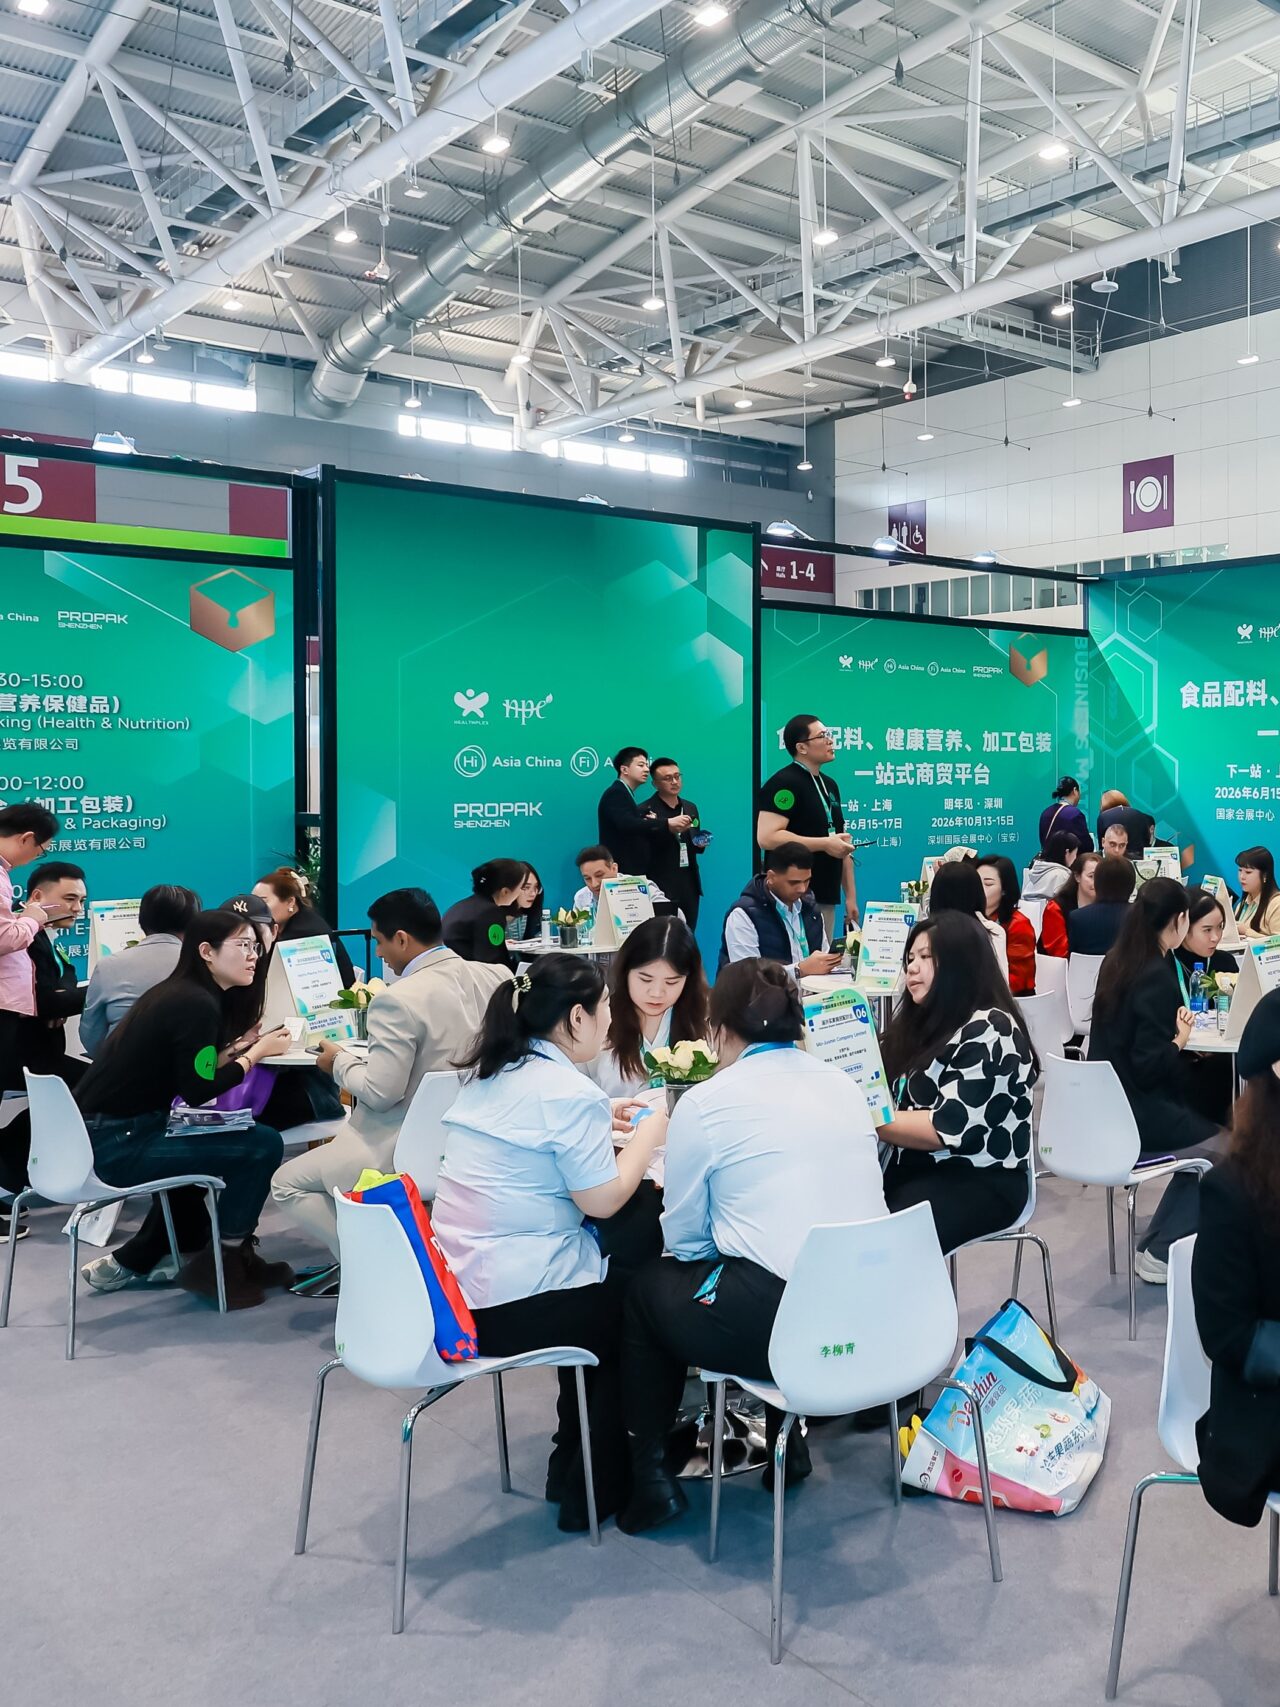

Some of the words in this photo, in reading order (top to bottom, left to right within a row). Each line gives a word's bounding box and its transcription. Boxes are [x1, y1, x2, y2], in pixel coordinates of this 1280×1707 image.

[3, 454, 43, 514] 5
[790, 560, 816, 581] 1-4
[7, 612, 40, 622] China
[57, 611, 129, 624] PROPAK
[57, 621, 103, 630] SHENZHEN
[972, 666, 1003, 674] PROPAK
[37, 714, 95, 729] (Health
[101, 717, 113, 729] &
[118, 717, 190, 730] Nutrition)
[463, 756, 478, 768] Hi
[492, 756, 521, 768] Asia
[525, 756, 562, 768] China
[578, 757, 591, 768] Fi
[854, 762, 990, 786] 一站式商贸平台
[454, 802, 544, 818] PROPAK
[64, 818, 77, 830] &
[82, 814, 167, 831] Packaging)
[454, 819, 511, 829] SHENZHEN
[931, 815, 1014, 828] 2026年10月13-15日
[233, 900, 248, 912] NY
[855, 1007, 867, 1018] 06
